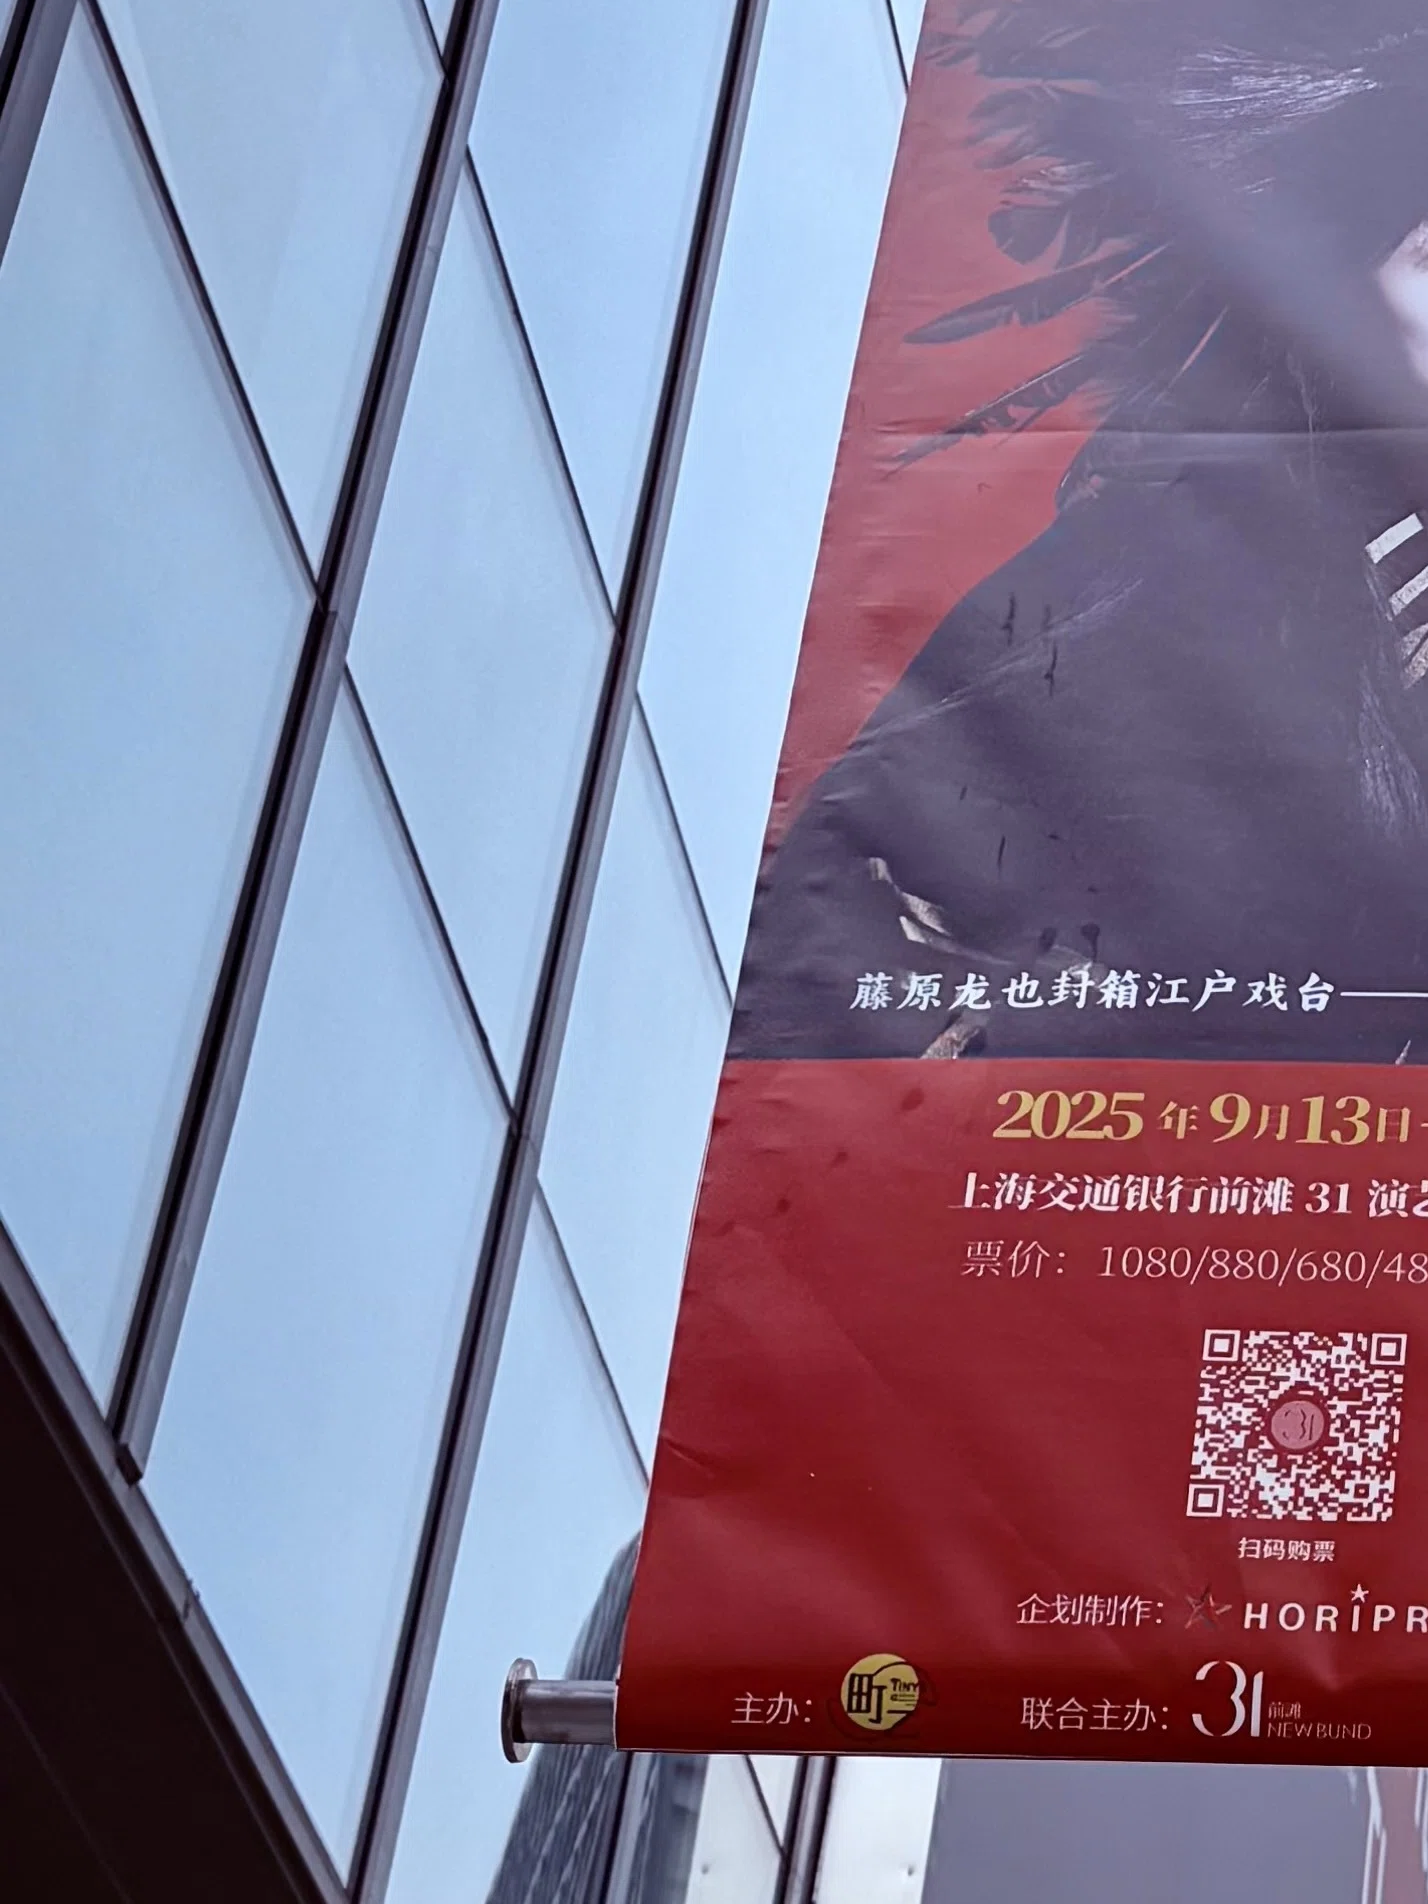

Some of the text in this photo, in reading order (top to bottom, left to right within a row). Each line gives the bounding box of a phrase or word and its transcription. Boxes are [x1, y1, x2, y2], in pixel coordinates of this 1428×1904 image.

[948, 1173, 1294, 1216] 上海交通银行前滩
[1238, 1537, 1336, 1563] 扫码购票
[1192, 1660, 1263, 1737] 31
[1267, 1722, 1372, 1740] NEW BUND
